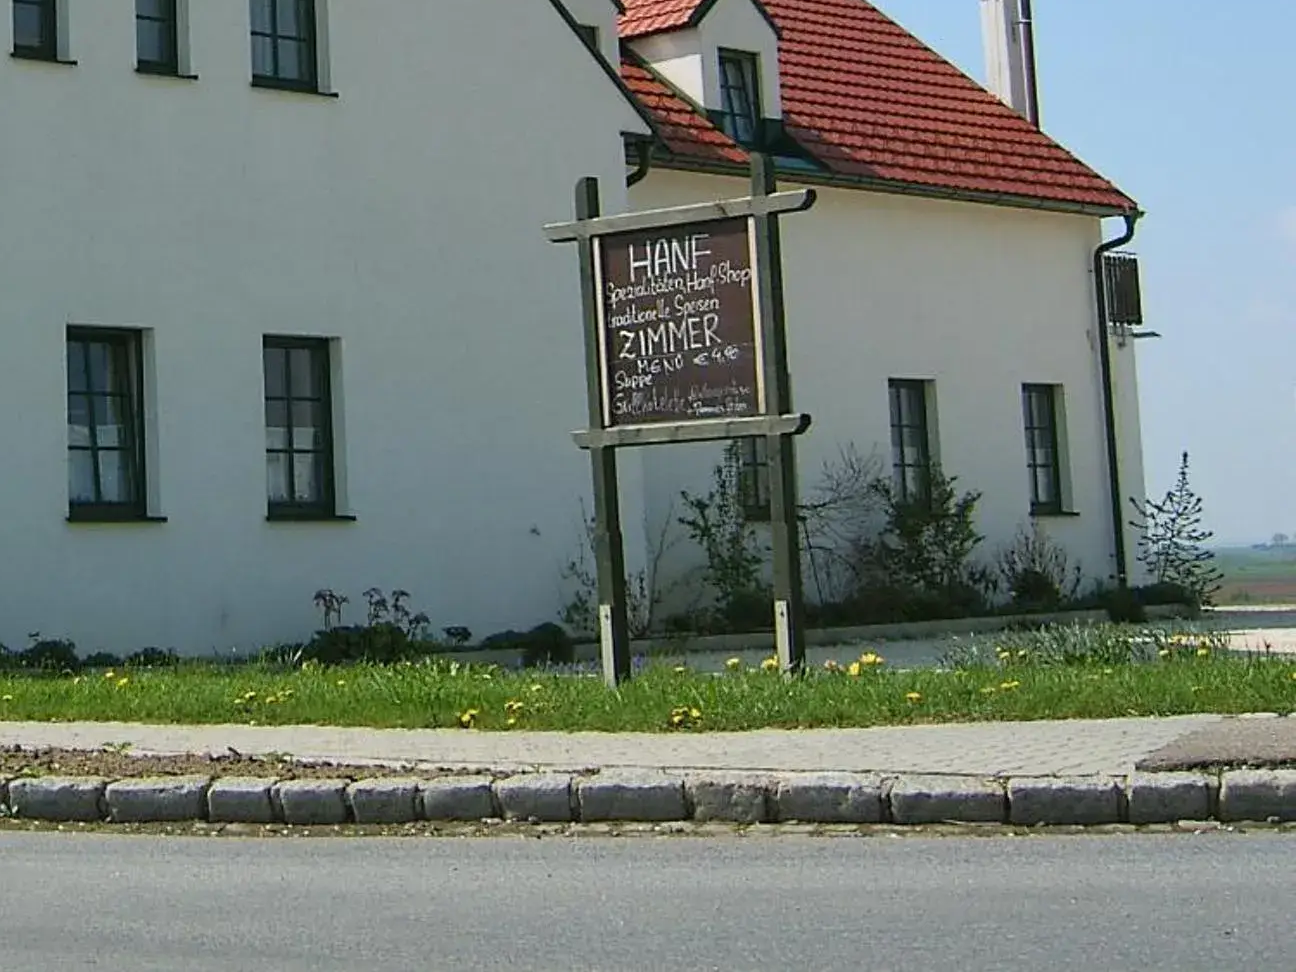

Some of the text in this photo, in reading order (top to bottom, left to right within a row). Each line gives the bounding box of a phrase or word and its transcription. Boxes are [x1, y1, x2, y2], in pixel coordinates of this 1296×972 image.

[628, 233, 712, 282] HANF
[618, 313, 722, 359] ZIMMER
[614, 370, 654, 391] Suppe
